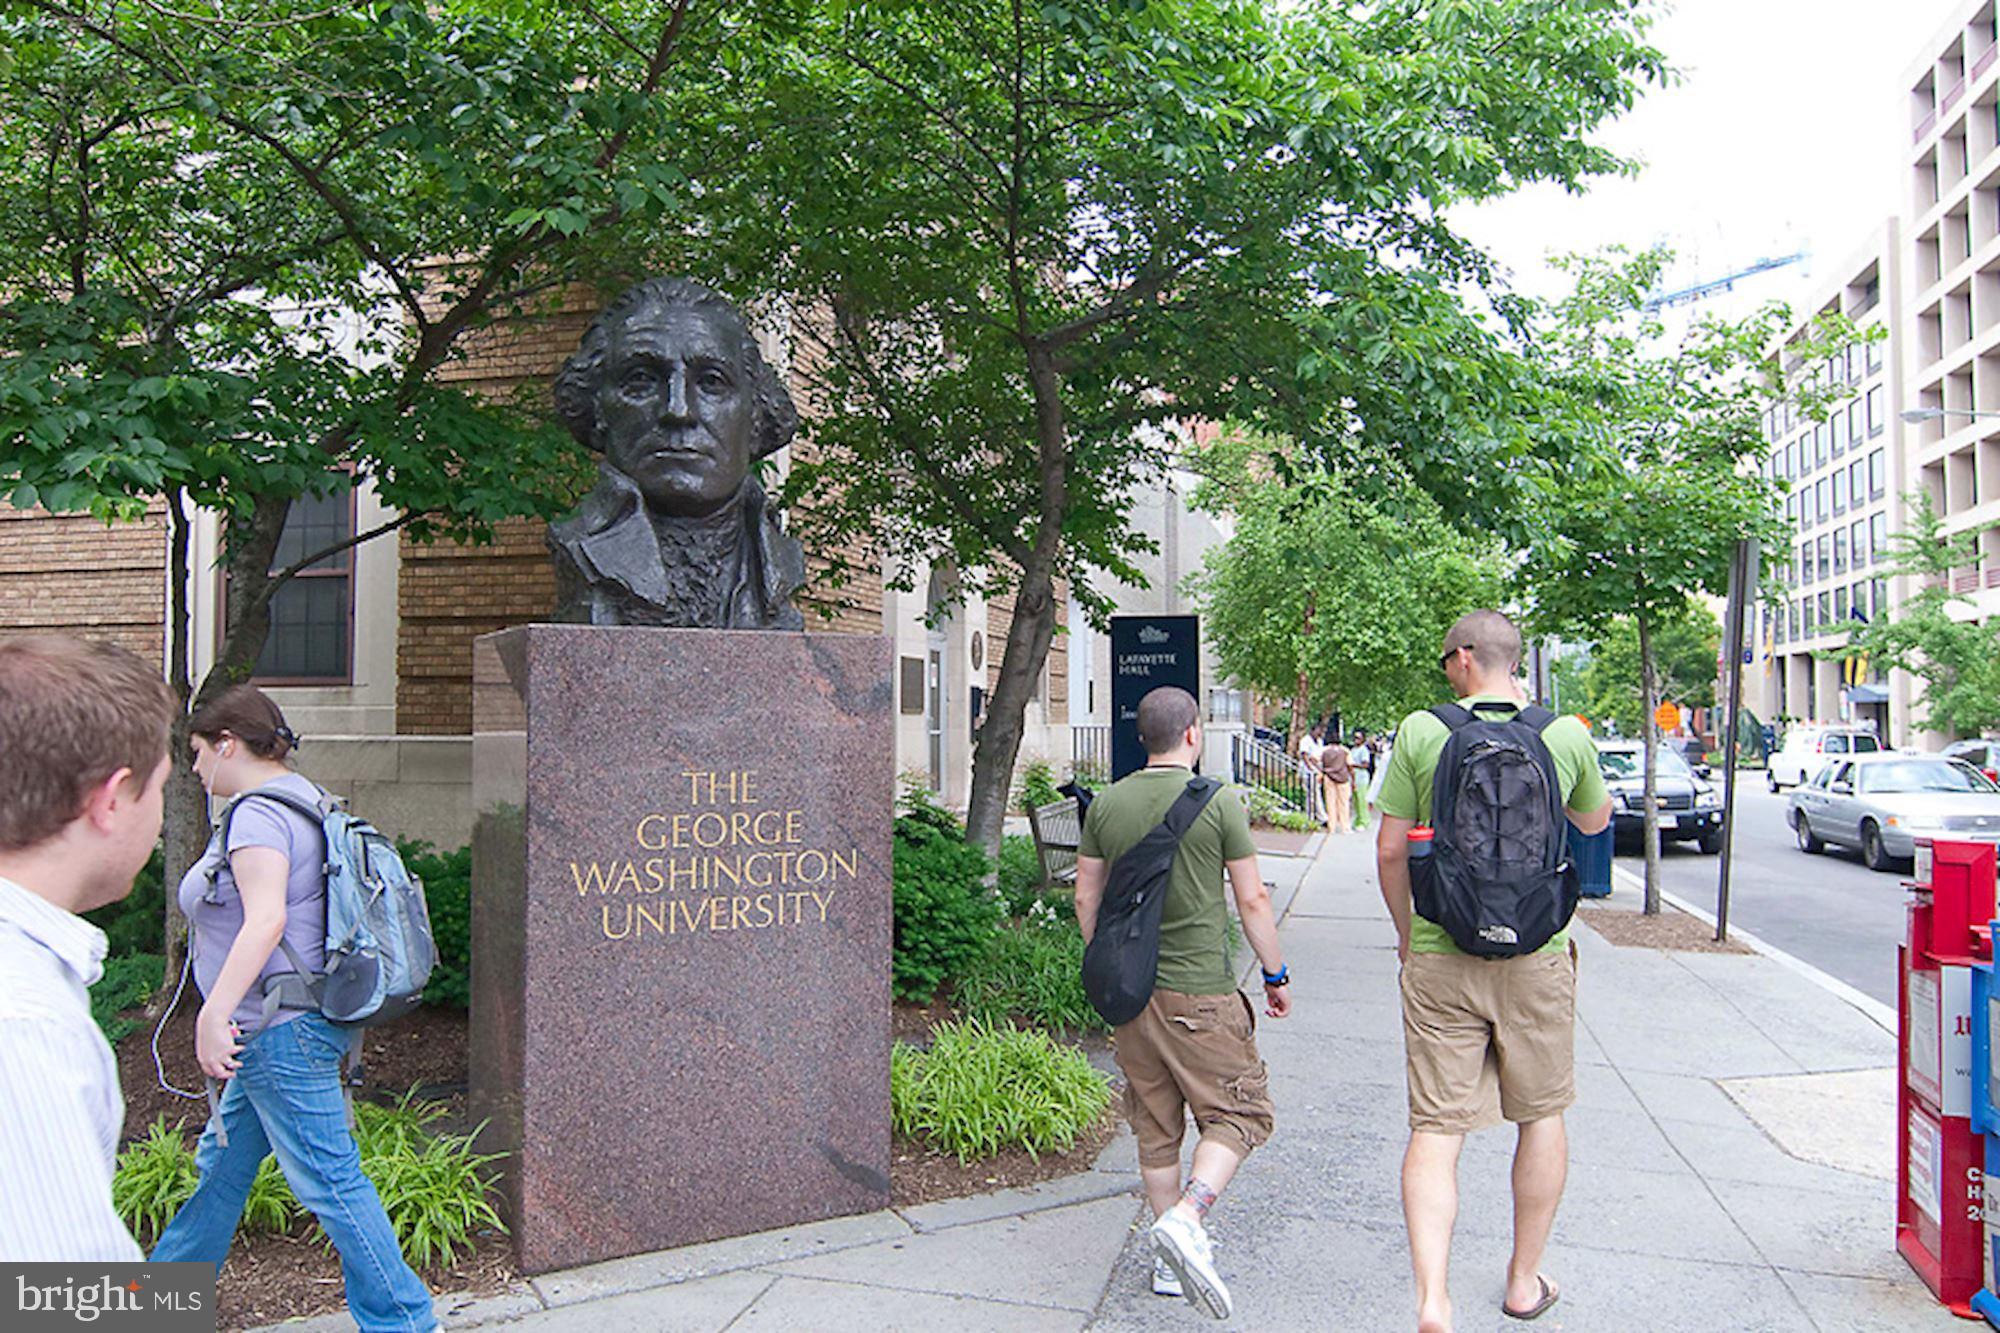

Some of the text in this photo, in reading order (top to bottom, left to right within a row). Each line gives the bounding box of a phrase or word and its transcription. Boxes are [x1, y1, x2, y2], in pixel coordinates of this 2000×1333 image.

[682, 771, 759, 805] THE
[636, 809, 803, 850] GEORGE
[570, 848, 858, 896] WASHINGTON
[602, 890, 836, 939] UNIVERSITY
